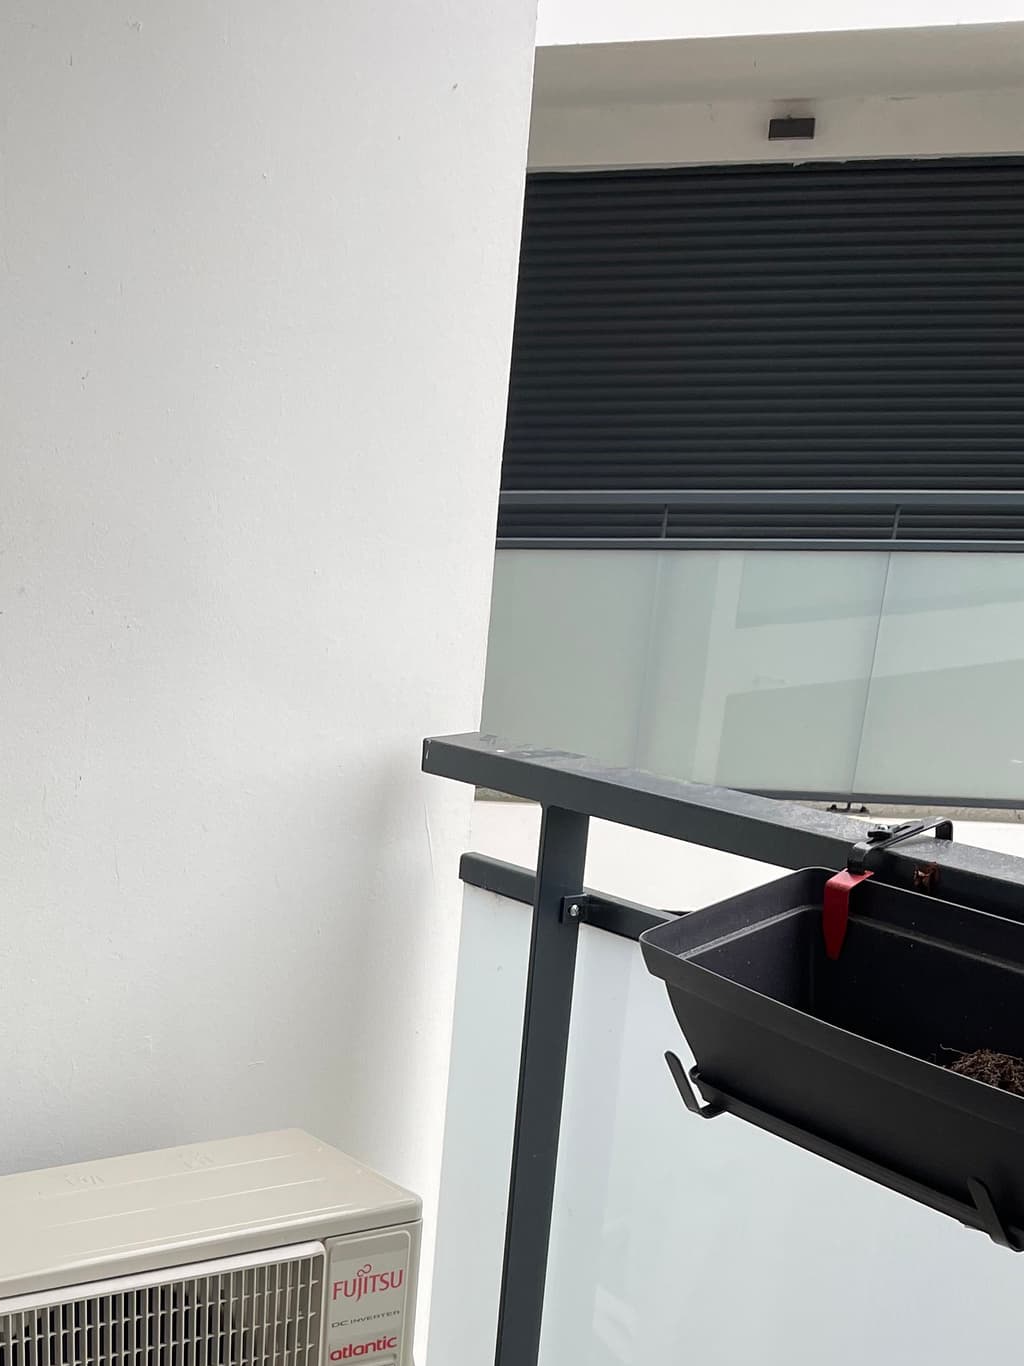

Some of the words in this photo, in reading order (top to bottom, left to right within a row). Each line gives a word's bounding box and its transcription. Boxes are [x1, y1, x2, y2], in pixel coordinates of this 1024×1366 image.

[332, 1264, 404, 1302] FUJITSU
[331, 1319, 349, 1328] DC
[350, 1310, 400, 1325] INVERTER
[330, 1336, 398, 1361] atlantic
